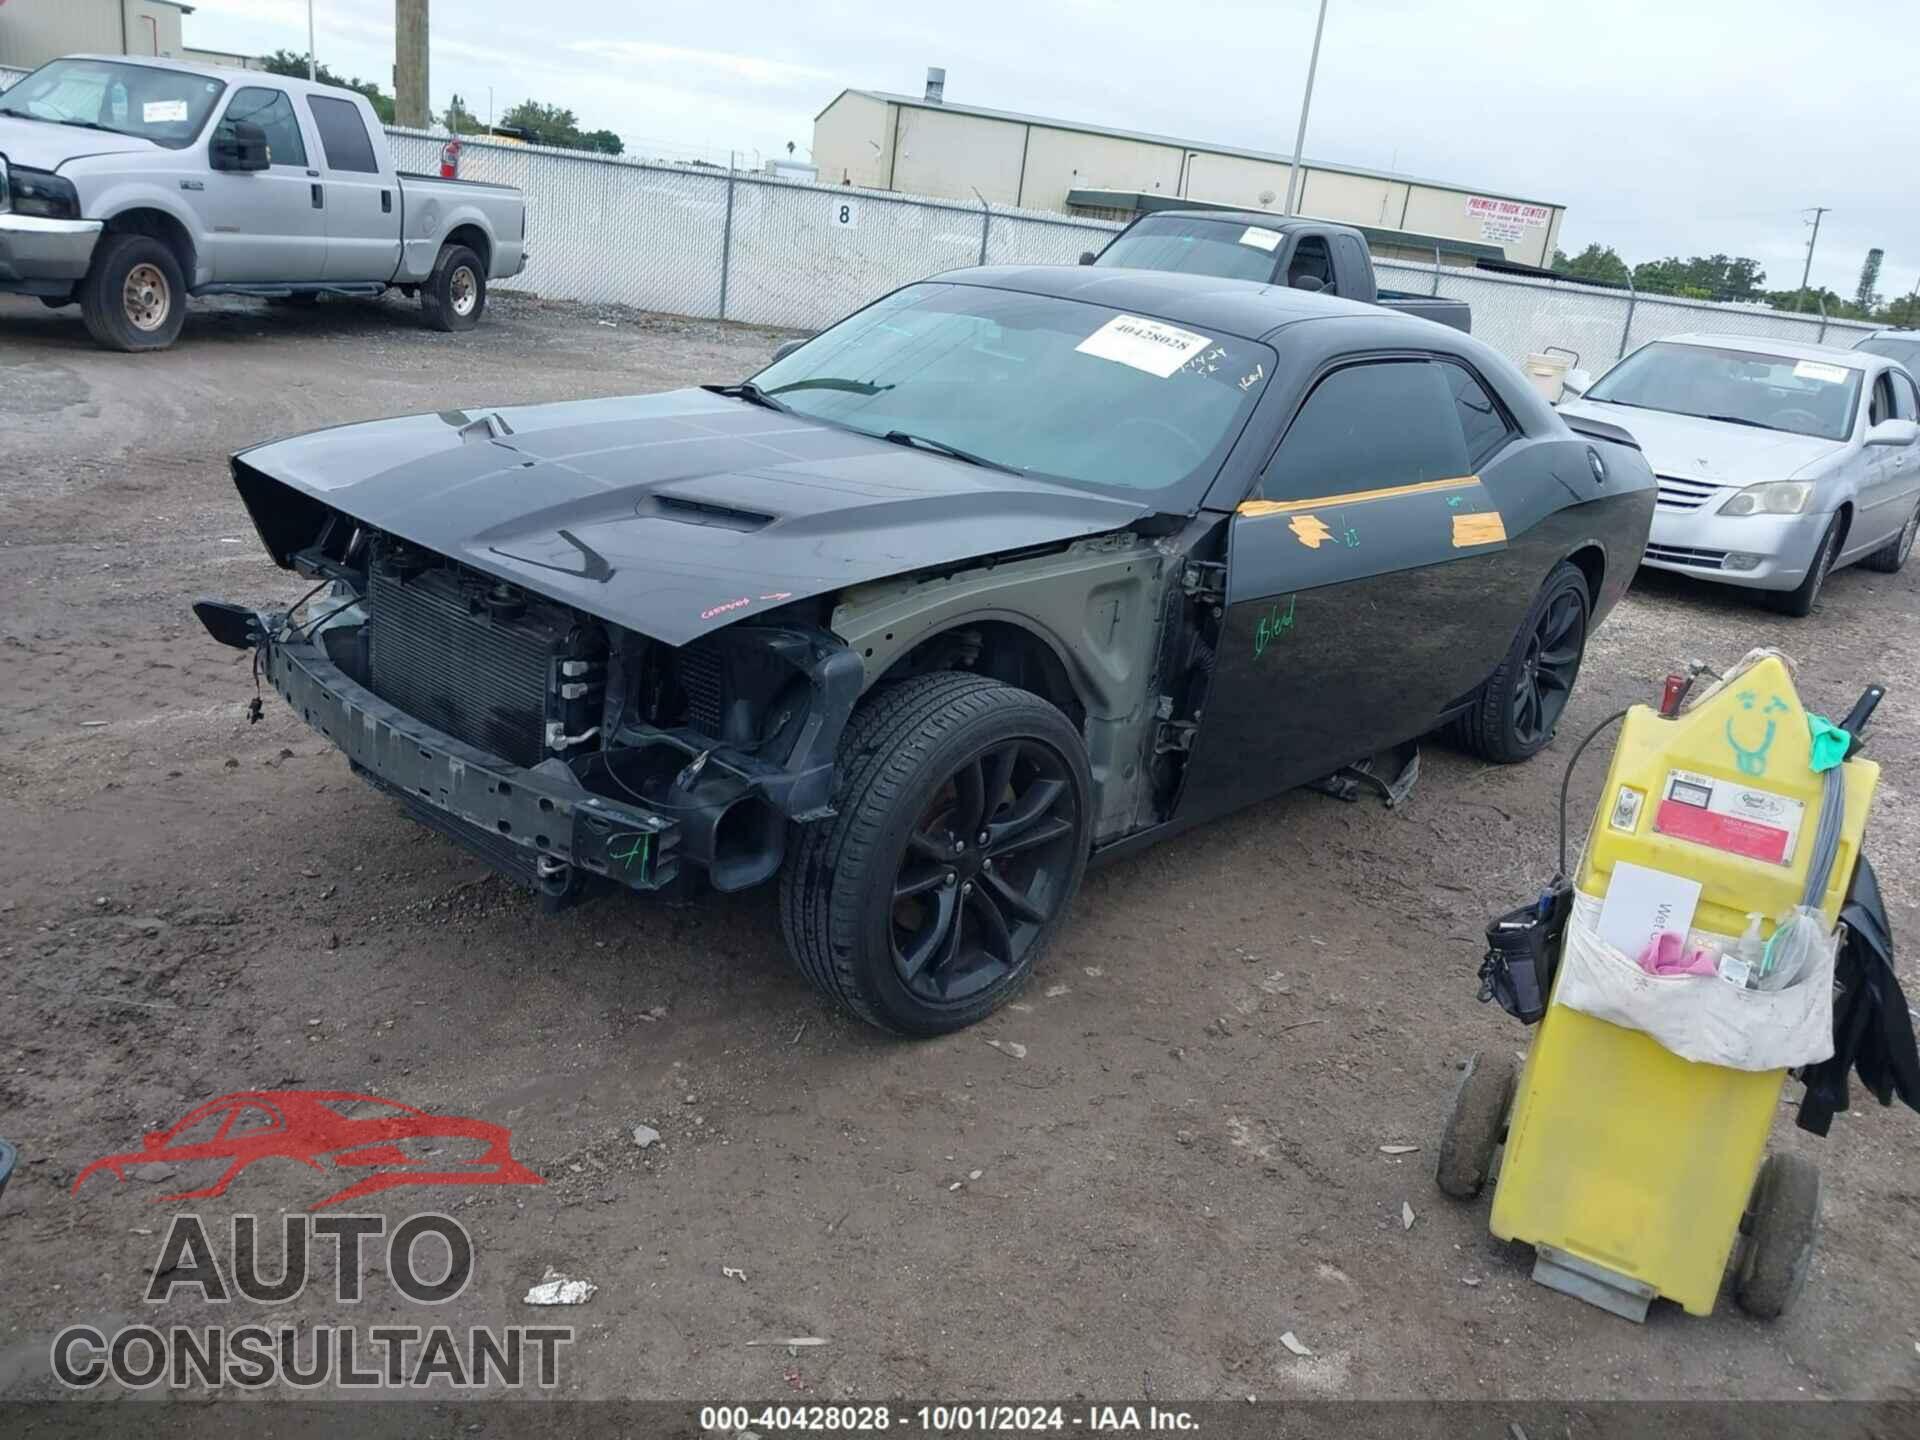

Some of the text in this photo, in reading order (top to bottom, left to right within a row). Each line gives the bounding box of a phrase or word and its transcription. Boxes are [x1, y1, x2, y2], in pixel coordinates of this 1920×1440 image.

[840, 205, 849, 224] 8
[1469, 198, 1548, 219] PREMIER TRUCK CENTER
[1115, 324, 1189, 350] 40428028
